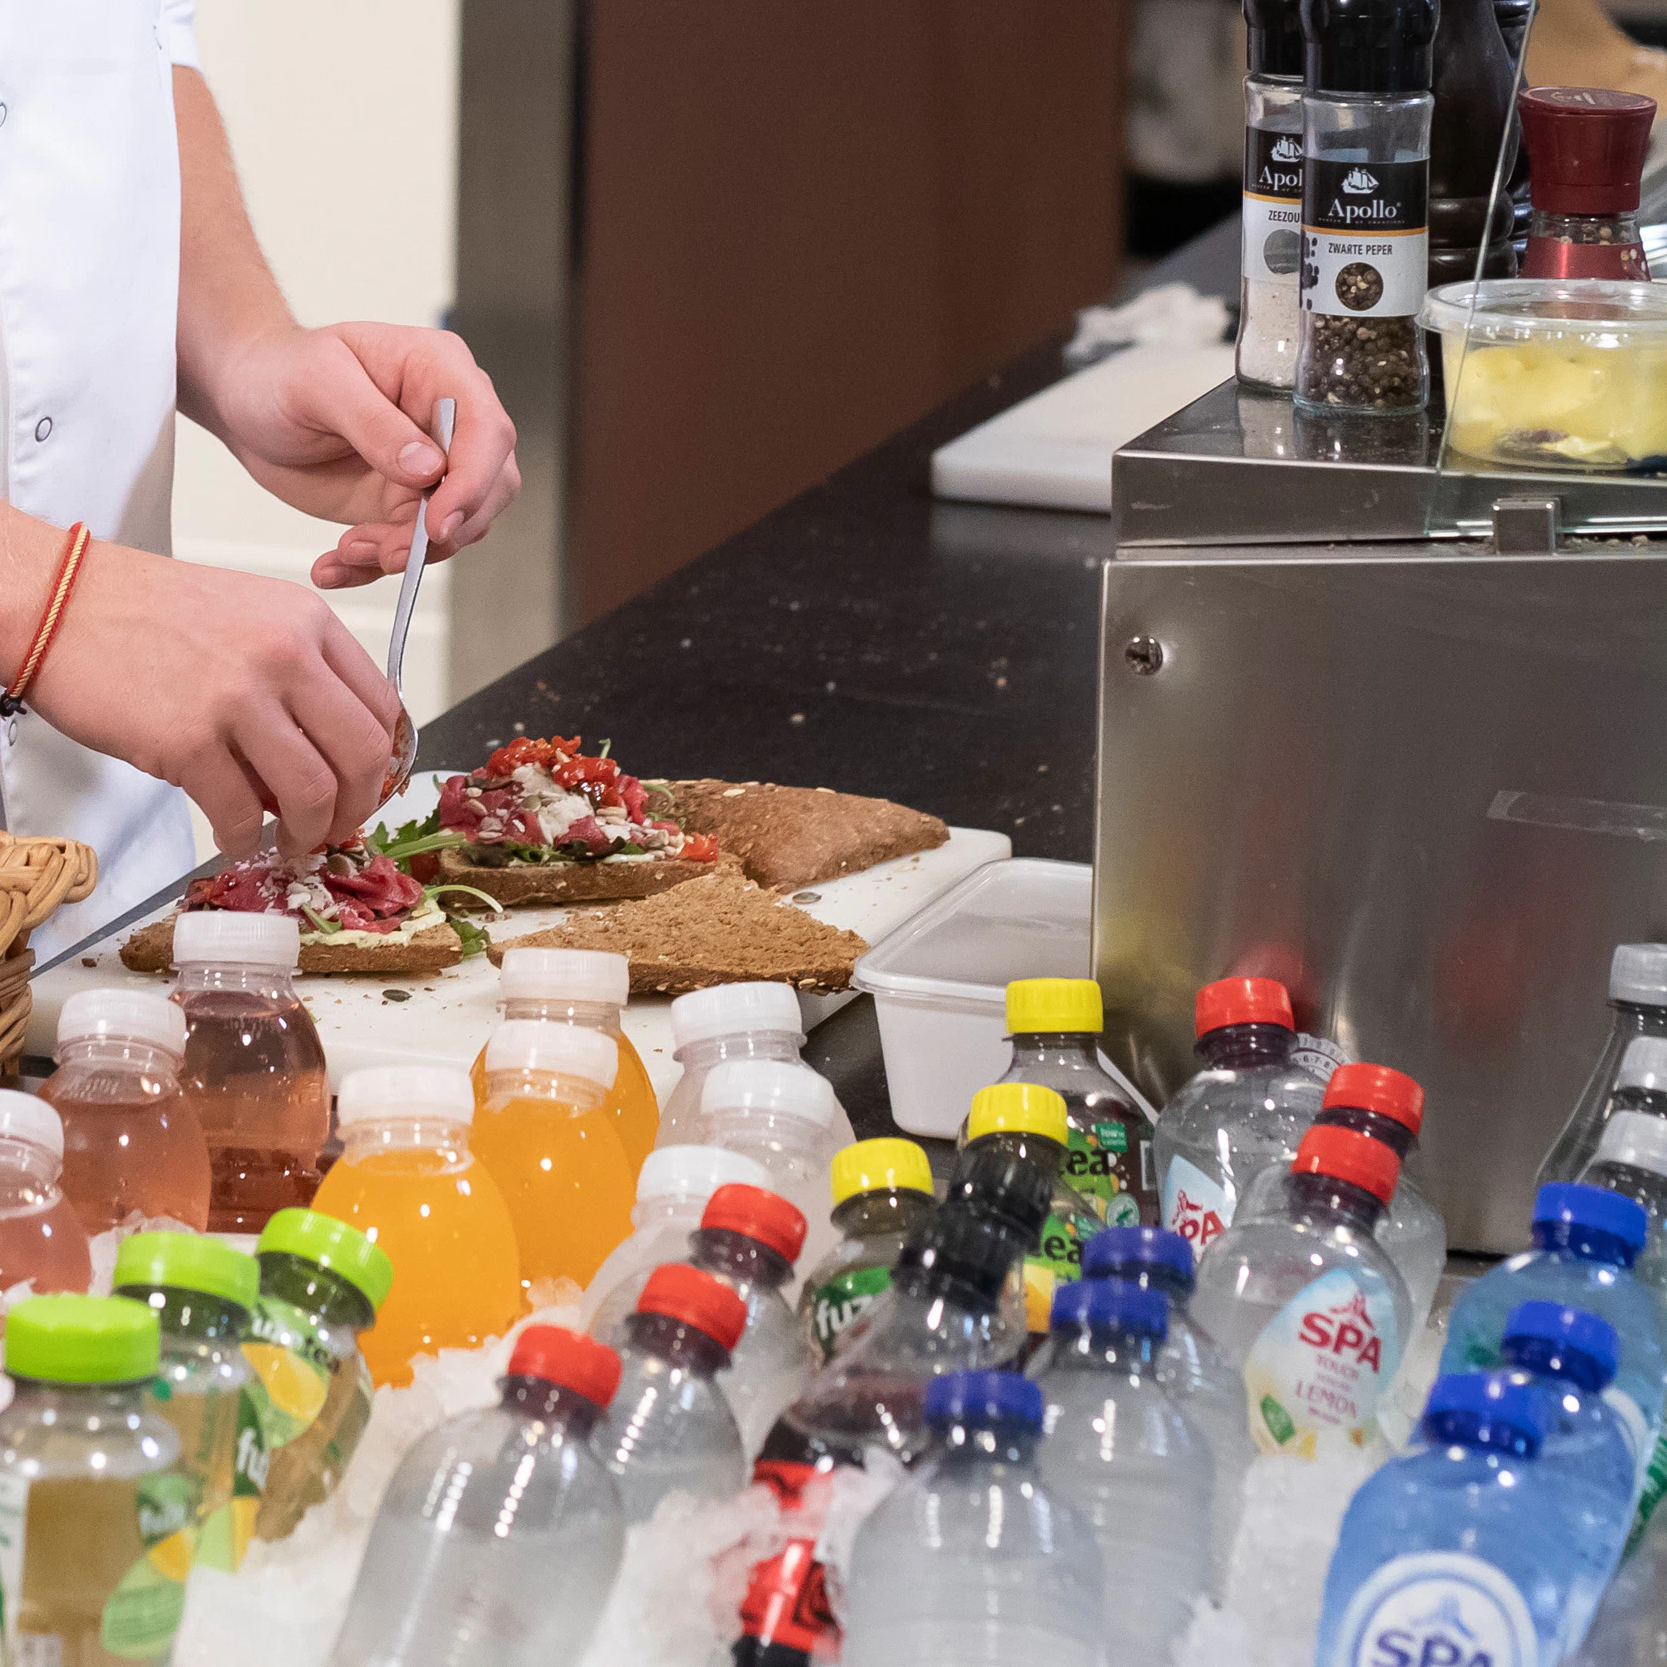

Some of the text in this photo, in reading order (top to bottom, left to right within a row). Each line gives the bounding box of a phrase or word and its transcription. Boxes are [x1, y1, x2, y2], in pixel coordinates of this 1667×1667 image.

[1328, 198, 1397, 224] Apollo
[1328, 242, 1393, 255] ZWARTE PEPER
[1061, 1149, 1111, 1176] ea
[1174, 1210, 1225, 1246] PA
[1298, 1311, 1382, 1375] SPA
